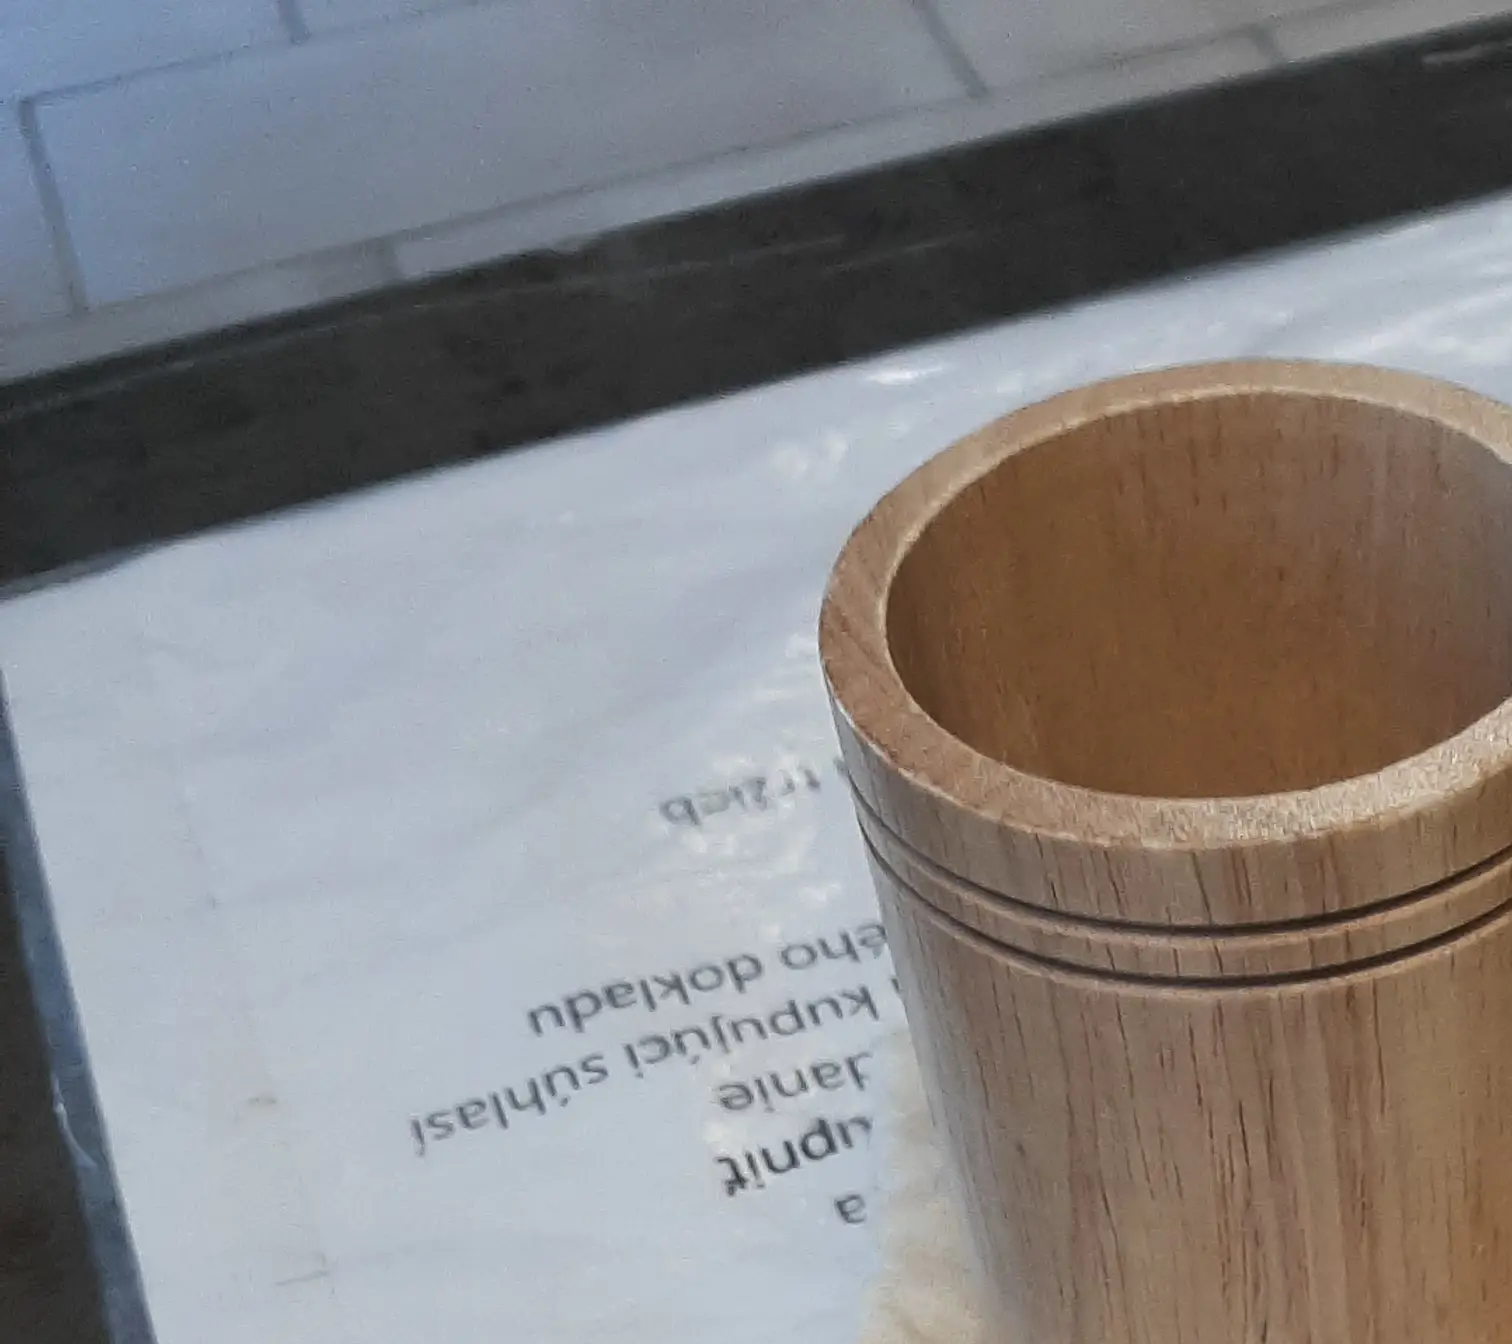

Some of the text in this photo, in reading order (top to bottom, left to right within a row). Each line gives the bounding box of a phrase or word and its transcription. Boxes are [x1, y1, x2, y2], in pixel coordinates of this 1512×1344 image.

[525, 951, 762, 1037] dokladu
[622, 984, 880, 1078] kupujúci
[409, 1052, 608, 1158] súhlasí
[833, 1193, 868, 1225] a
